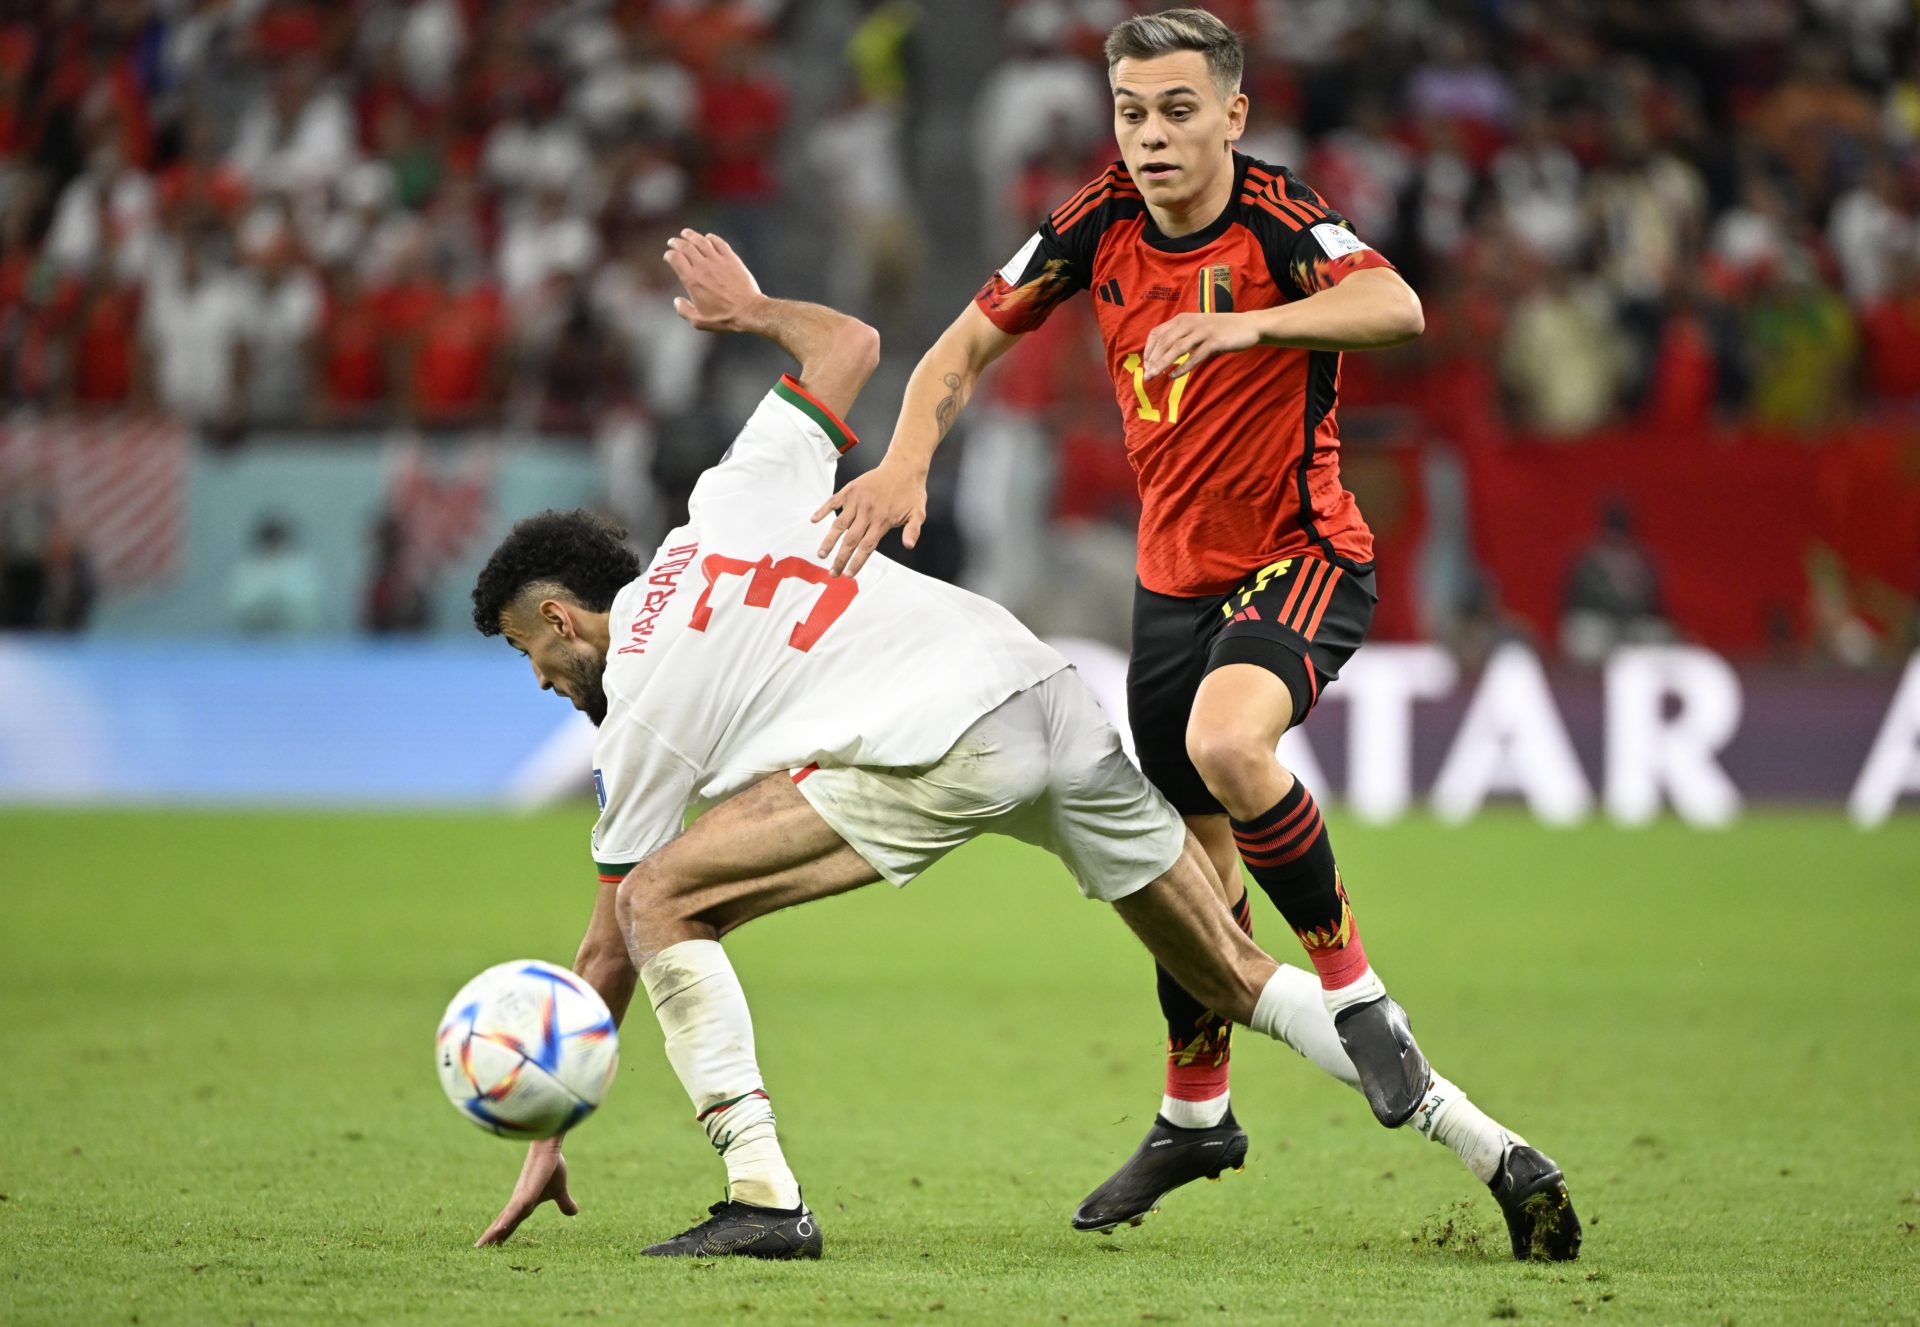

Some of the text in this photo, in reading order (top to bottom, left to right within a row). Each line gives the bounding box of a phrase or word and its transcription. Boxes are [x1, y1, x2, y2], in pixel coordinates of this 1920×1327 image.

[617, 542, 699, 654] MAZRAOUI
[688, 552, 859, 653] 3
[1050, 640, 1744, 830] TAR
